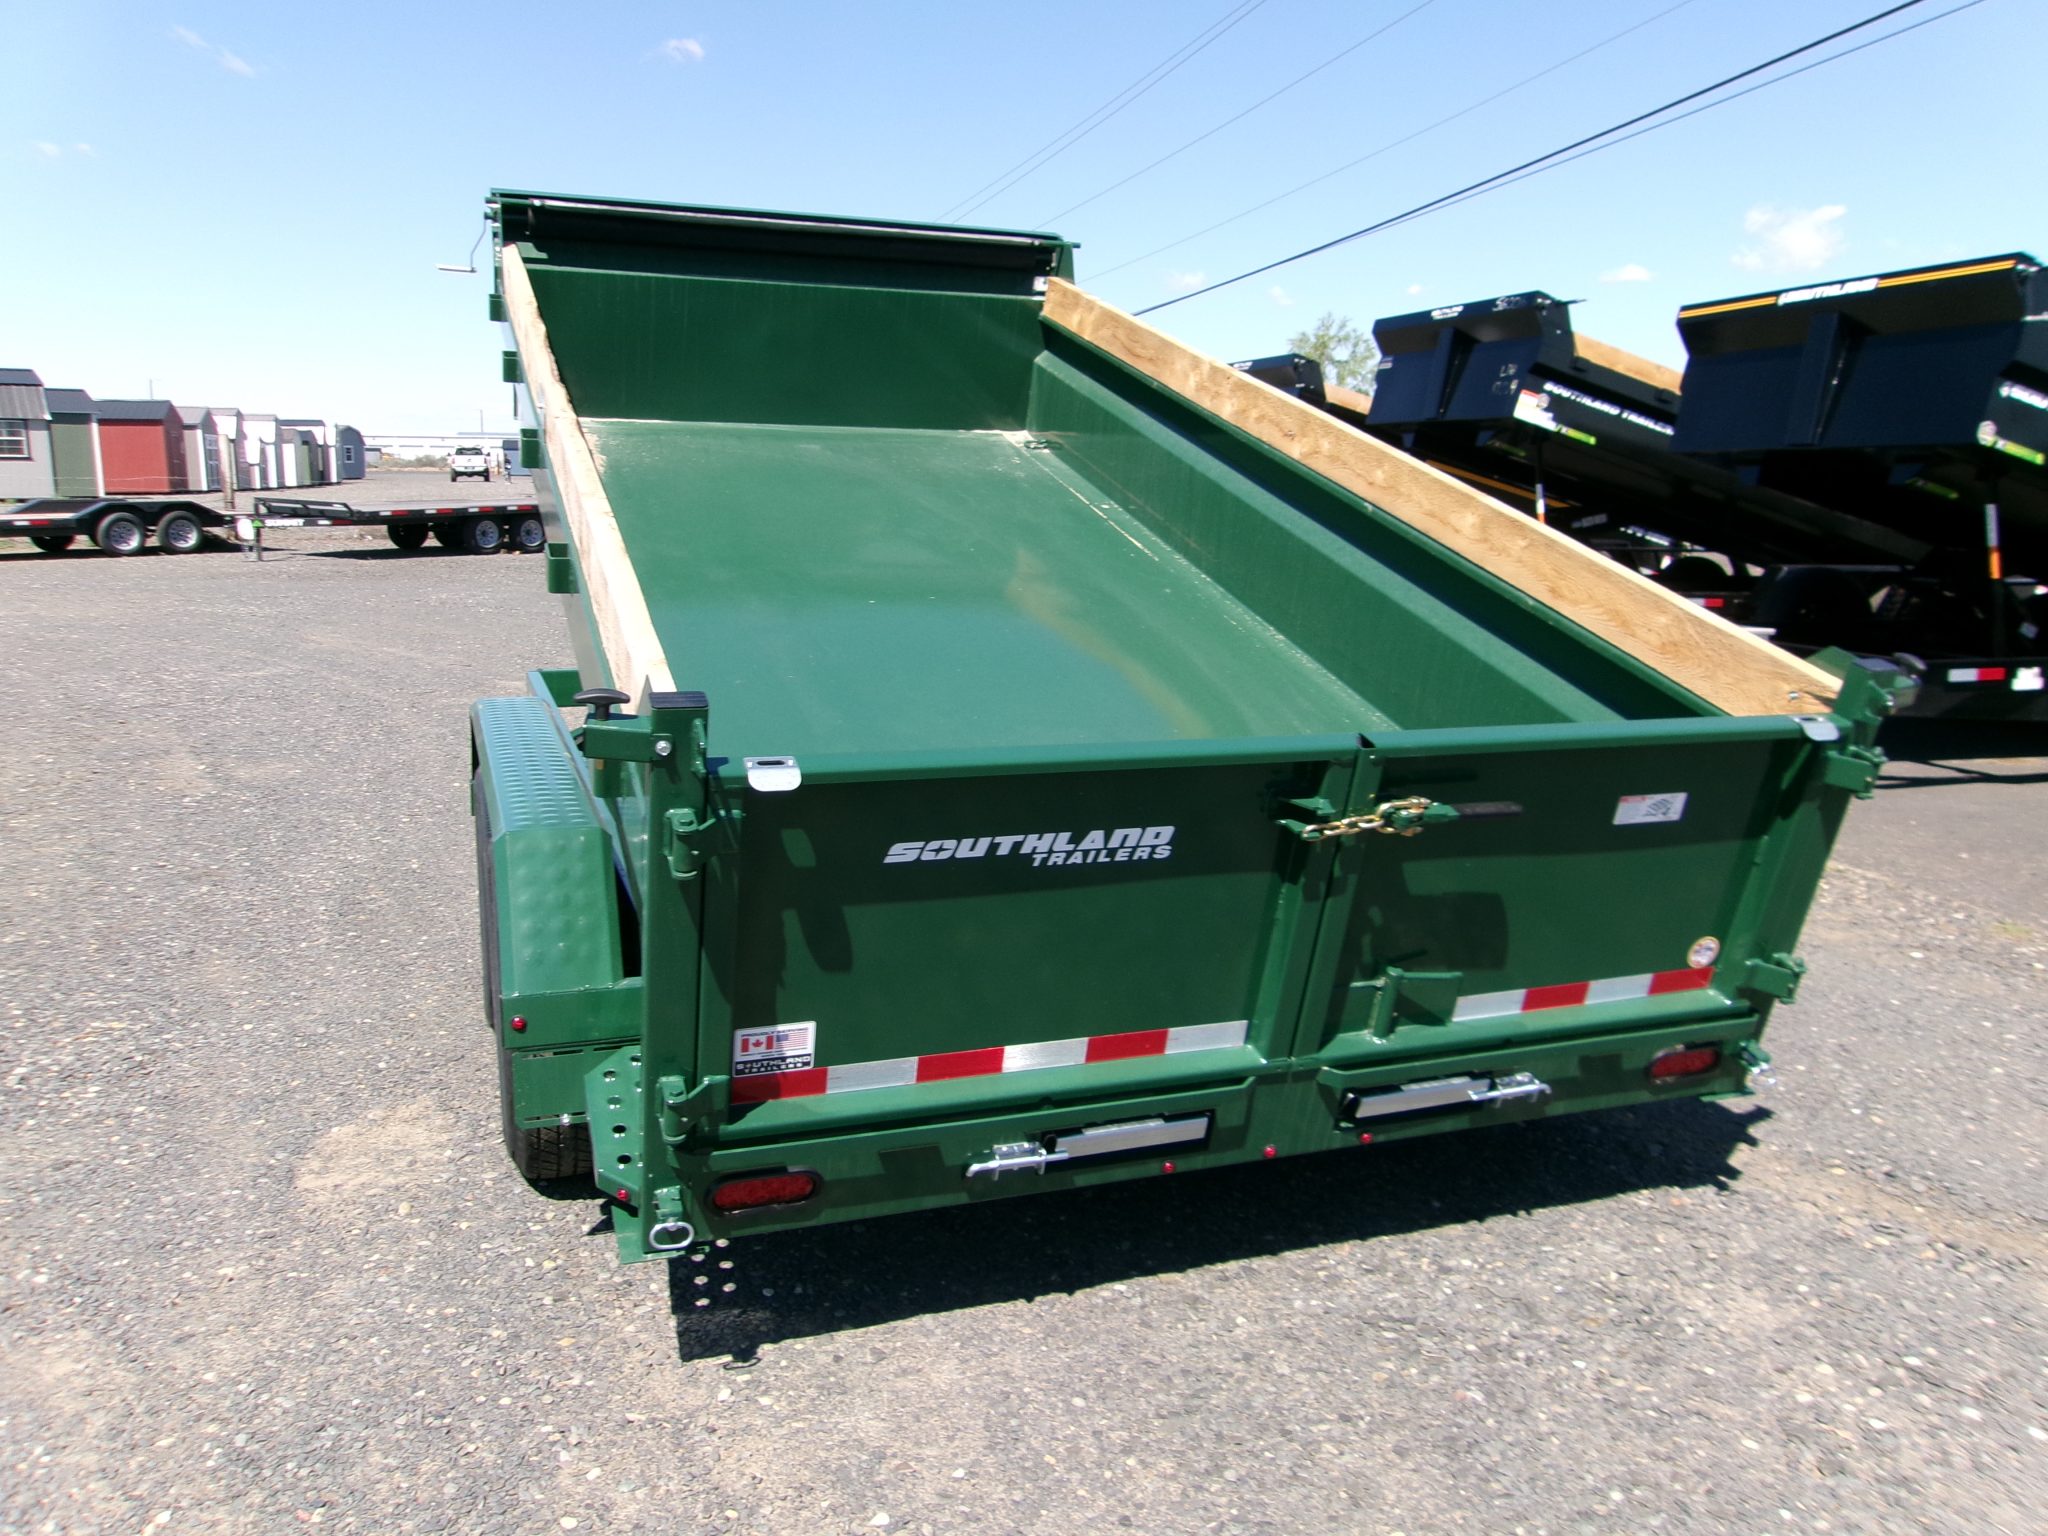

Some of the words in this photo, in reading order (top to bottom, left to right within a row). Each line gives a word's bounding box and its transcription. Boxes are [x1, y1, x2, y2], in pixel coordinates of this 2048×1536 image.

[883, 826, 1175, 863] SOUTHLAND
[1032, 846, 1172, 866] TRAILERS
[736, 1056, 811, 1070] SOUTHLAND
[744, 1062, 803, 1073] TRAILERS
